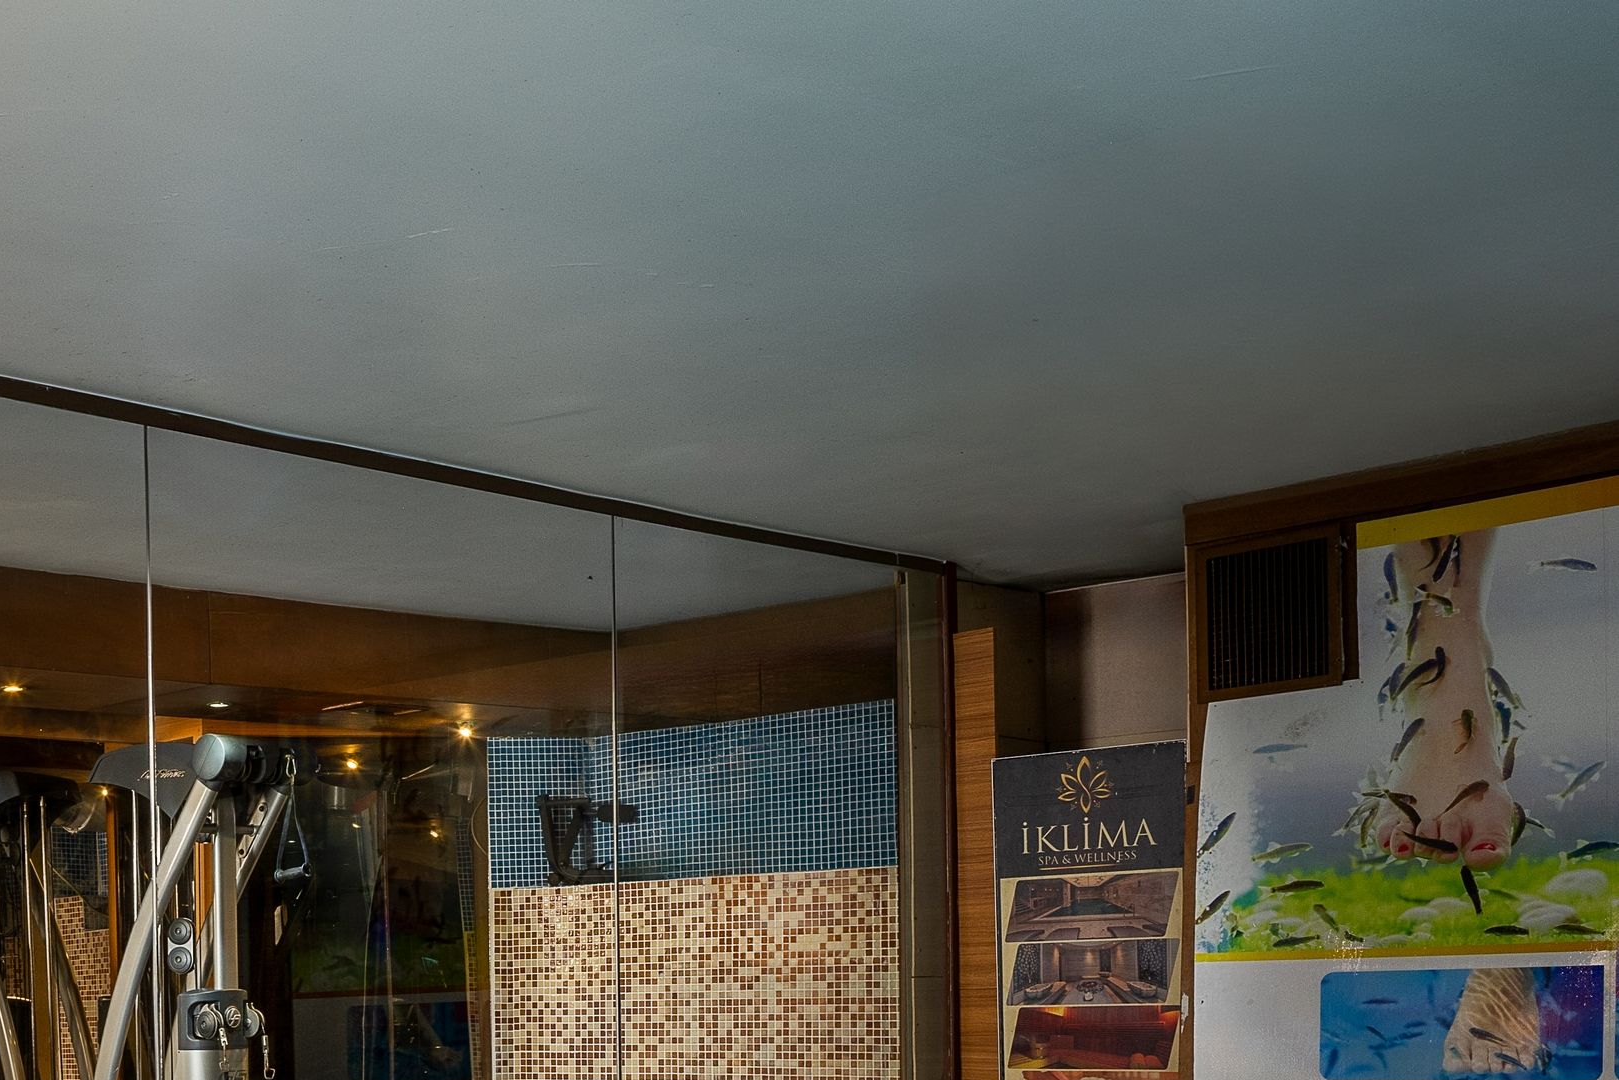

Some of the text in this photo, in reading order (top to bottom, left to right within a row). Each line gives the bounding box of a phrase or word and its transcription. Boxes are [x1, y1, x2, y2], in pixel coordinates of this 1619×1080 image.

[1021, 817, 1157, 855] İKLİMA
[1038, 850, 1137, 866] SPA & WELLNESS
